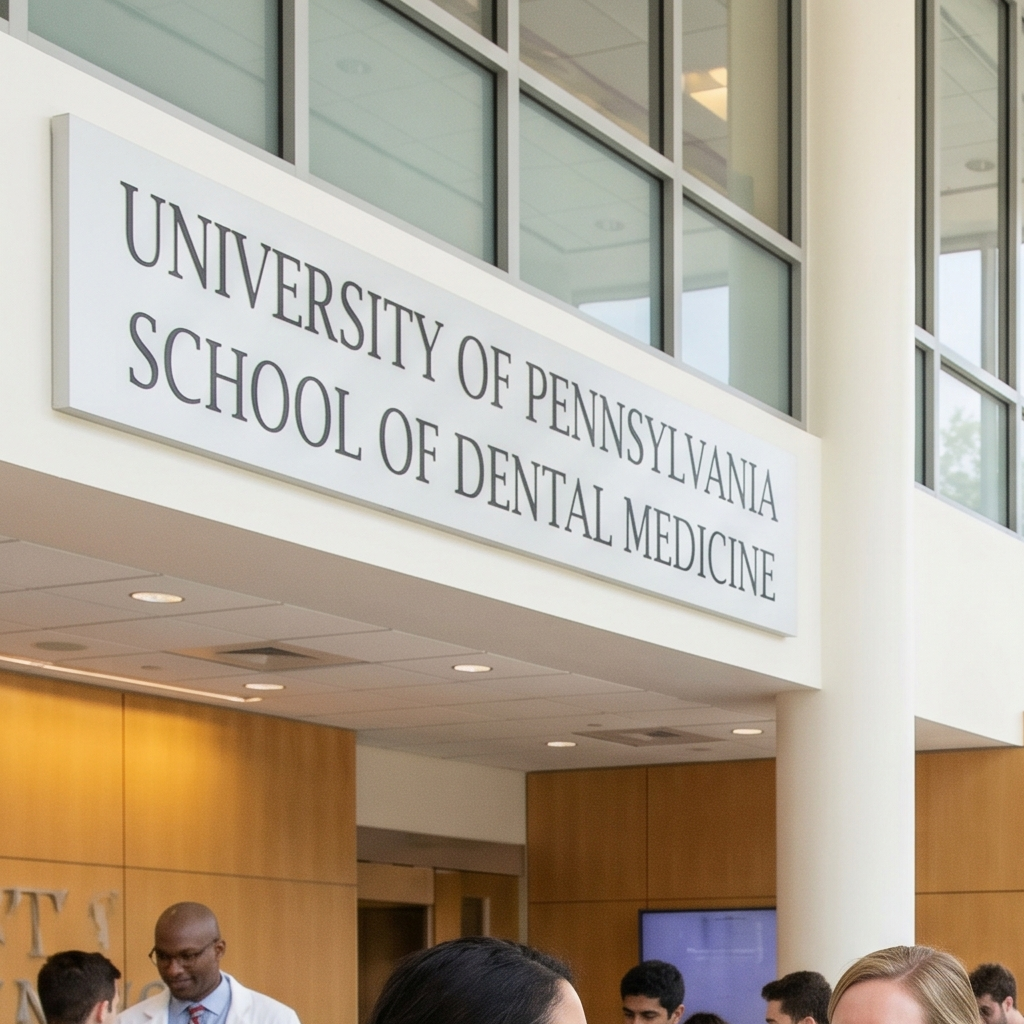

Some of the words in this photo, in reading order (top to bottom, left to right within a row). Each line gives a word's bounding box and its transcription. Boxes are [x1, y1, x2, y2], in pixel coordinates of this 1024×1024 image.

[120, 180, 444, 383] UNIVERSITY
[457, 334, 512, 412] OF
[525, 360, 779, 523] PENNSYLVANIA
[129, 311, 362, 461] SCHOOL
[379, 406, 439, 484] OF
[454, 432, 613, 547] DENTAL
[623, 495, 777, 602] MEDICINE
